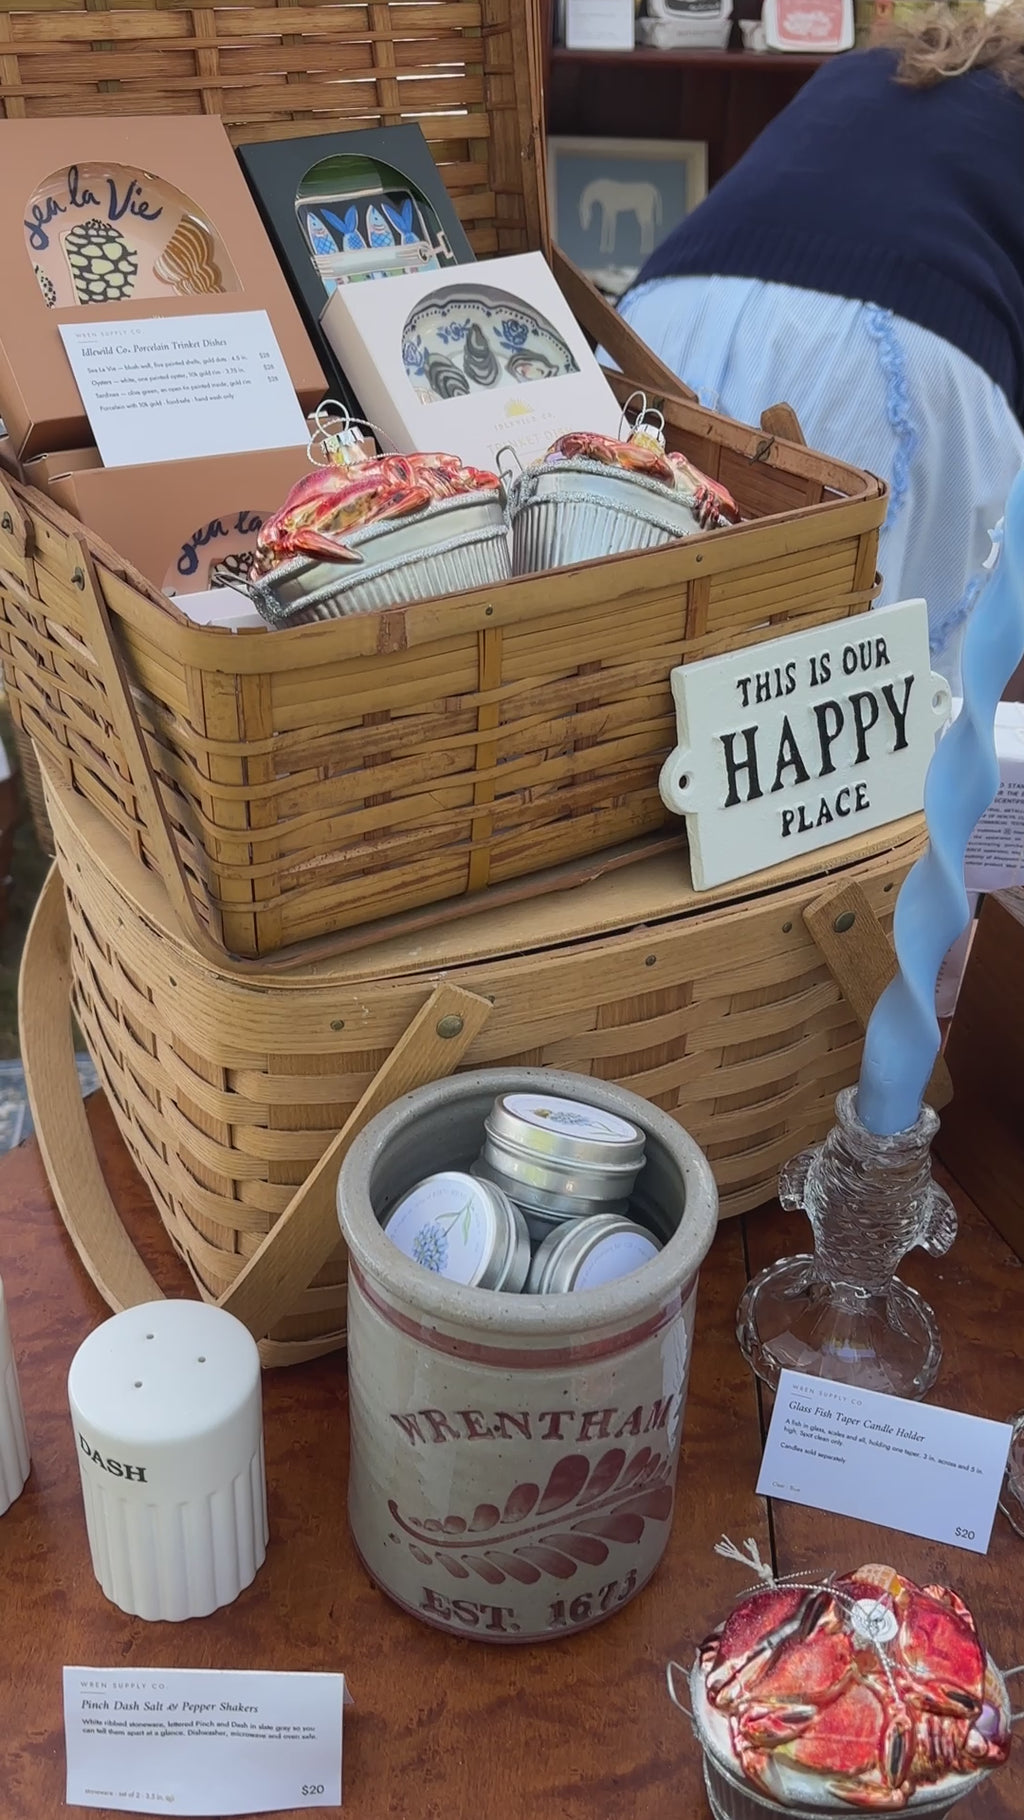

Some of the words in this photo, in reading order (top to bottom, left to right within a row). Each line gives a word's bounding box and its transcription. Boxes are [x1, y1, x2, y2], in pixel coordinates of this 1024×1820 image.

[106, 179, 164, 221] Vie
[81, 346, 114, 357] Idlewild
[115, 345, 131, 355] Co.
[133, 342, 170, 353] Porcelain
[171, 340, 200, 350] Trinket
[202, 338, 227, 348] Dishes
[737, 661, 796, 707] THIS
[810, 652, 831, 687] IS
[843, 637, 890, 676] OUR
[719, 675, 915, 808] HAPPY
[781, 783, 870, 837] PLACE
[792, 1384, 815, 1394] WREN
[819, 1390, 847, 1402] SUPPLY
[391, 1395, 674, 1447] WRENTHAM
[789, 1401, 812, 1414] Glass
[814, 1407, 832, 1419] Fish
[836, 1412, 861, 1426] Taper
[863, 1420, 894, 1434] Candle
[896, 1427, 926, 1442] Holder
[814, 1434, 830, 1442] clean
[868, 1439, 891, 1451] holding
[780, 1442, 803, 1453] Candles
[79, 1433, 148, 1483] DASH
[954, 1526, 975, 1540] $20
[419, 1586, 521, 1632] EST.
[112, 1682, 146, 1690] SUPPLY
[81, 1699, 109, 1710] Pinch
[114, 1701, 139, 1711] Dash
[143, 1701, 163, 1711] Salt
[182, 1702, 216, 1714] Pepper
[219, 1702, 258, 1713] Shakers
[81, 1718, 103, 1726] White
[108, 1728, 125, 1736] them
[230, 1731, 267, 1739] microwave
[301, 1784, 325, 1796] $20
